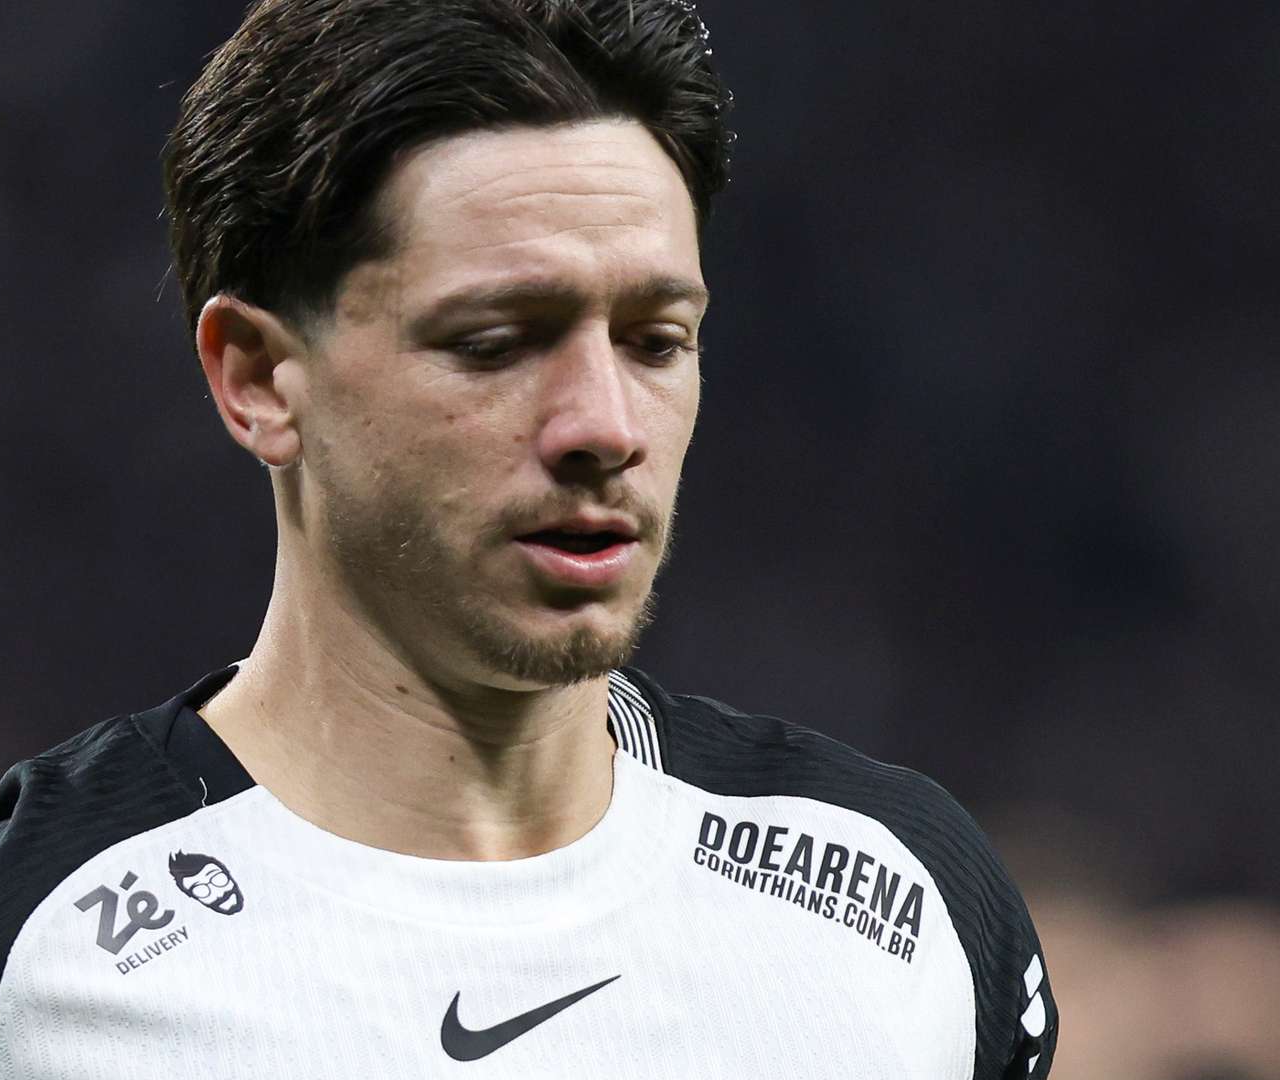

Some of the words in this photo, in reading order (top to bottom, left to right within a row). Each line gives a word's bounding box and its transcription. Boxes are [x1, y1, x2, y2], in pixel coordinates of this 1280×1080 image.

[73, 870, 175, 956] Zé
[693, 847, 916, 964] CORINTHIANS.COM.BR
[698, 811, 925, 938] DOEARENA
[115, 926, 189, 975] DELIVERY
